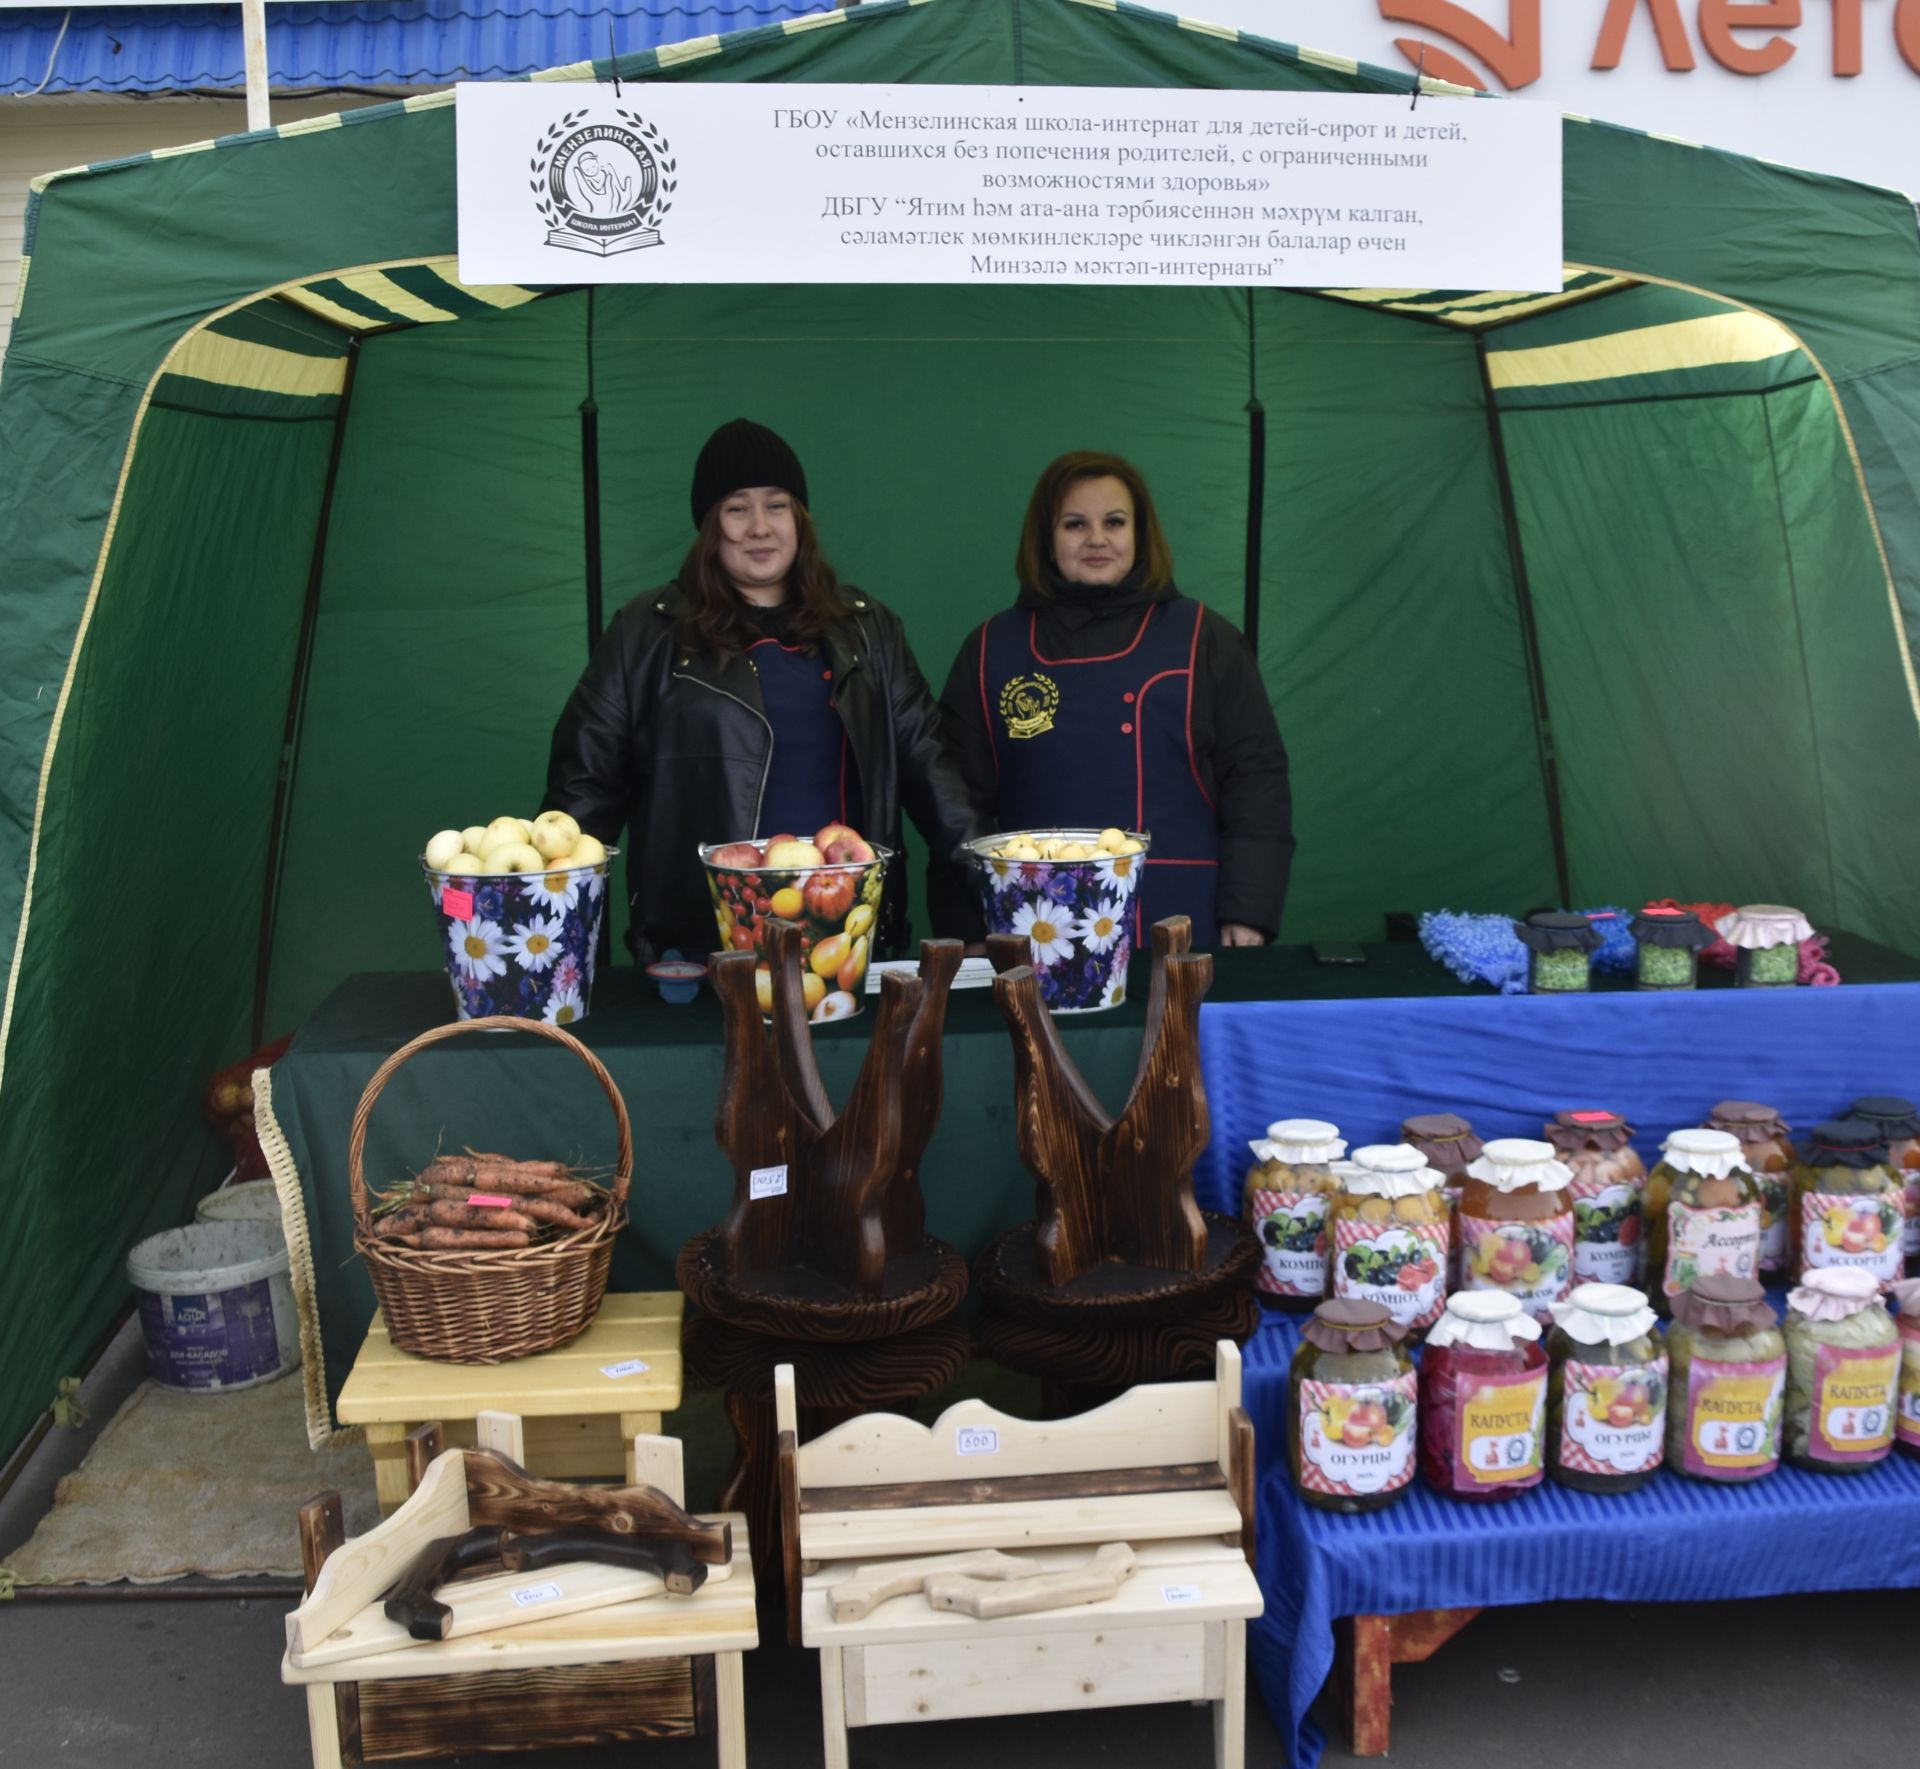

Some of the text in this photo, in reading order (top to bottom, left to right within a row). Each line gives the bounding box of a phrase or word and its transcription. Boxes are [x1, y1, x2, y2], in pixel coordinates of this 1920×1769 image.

[773, 109, 1468, 143] ГБОУ «Мензелинская школа-интернат для детей-сирот и детей,
[554, 127, 653, 169] МЕНЗЕЛИНСКАЯ
[815, 139, 1428, 170] оставшихся без попечения родителей, с ограниченными
[982, 174, 1271, 196] возможностями здоровья»
[820, 196, 1424, 227] ДБГУ “Ятим һәм ата-ана тәрбиясеннән мәхрүм калган,
[571, 217, 598, 231] ШКОЛА
[840, 229, 1406, 255] сәламәтлек мөмкинлекләре чикләнгән балалар өчен
[970, 254, 1285, 281] Минзәлә мәктәп-интернаты”
[1829, 1256, 1887, 1266] АССОРТИ
[1830, 1384, 1886, 1400] КАПУСТА
[1702, 1398, 1763, 1416] КАПУСТА
[1471, 1411, 1530, 1429] КАПУСТА
[1330, 1450, 1392, 1466] ОГУРЦЫ
